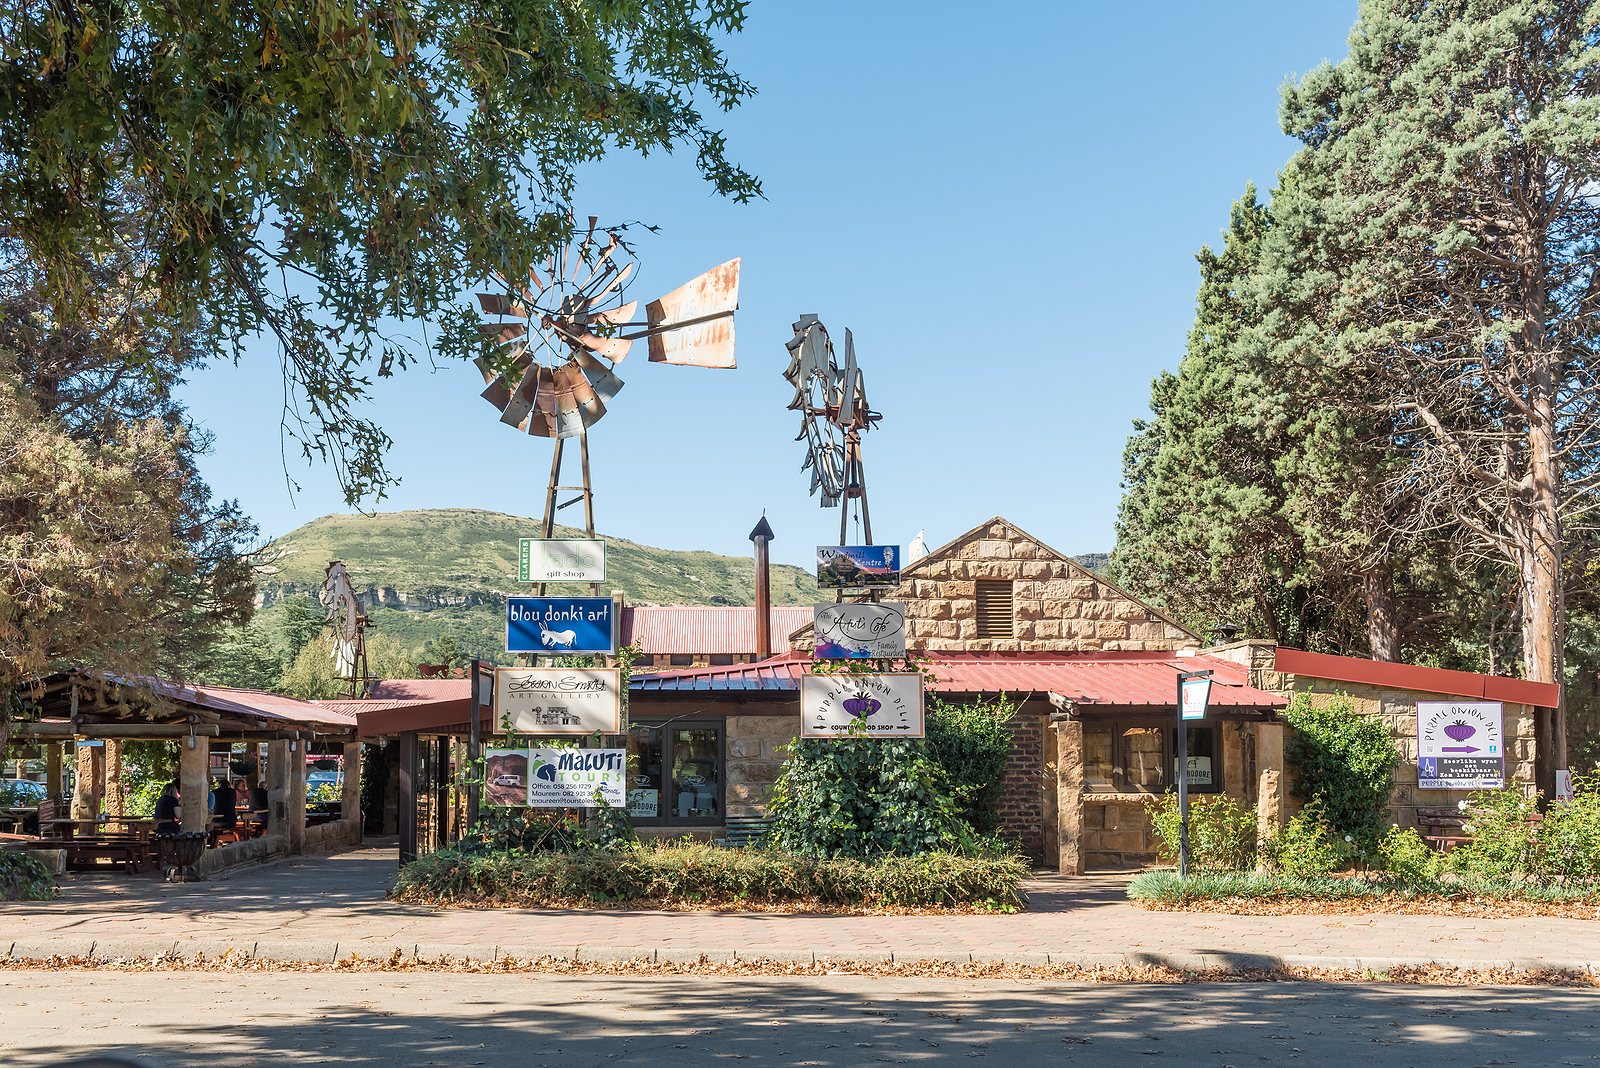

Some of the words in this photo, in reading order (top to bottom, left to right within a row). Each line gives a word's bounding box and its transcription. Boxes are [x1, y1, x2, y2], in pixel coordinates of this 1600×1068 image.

[541, 543, 596, 569] kado
[820, 549, 865, 559] Windmill
[546, 571, 561, 579] gift
[563, 571, 585, 579] shop
[510, 605, 540, 621] blou
[544, 605, 583, 621] donki
[587, 605, 608, 621] art
[877, 641, 899, 651] Family
[871, 649, 904, 658] Restaurant
[816, 683, 850, 721] PURPLE
[854, 680, 891, 696] ONION
[893, 697, 910, 722] DELI
[1424, 709, 1448, 741] PURPLE
[1451, 706, 1487, 721] ONION
[1485, 722, 1498, 742] DELI
[559, 773, 621, 782] TOURS
